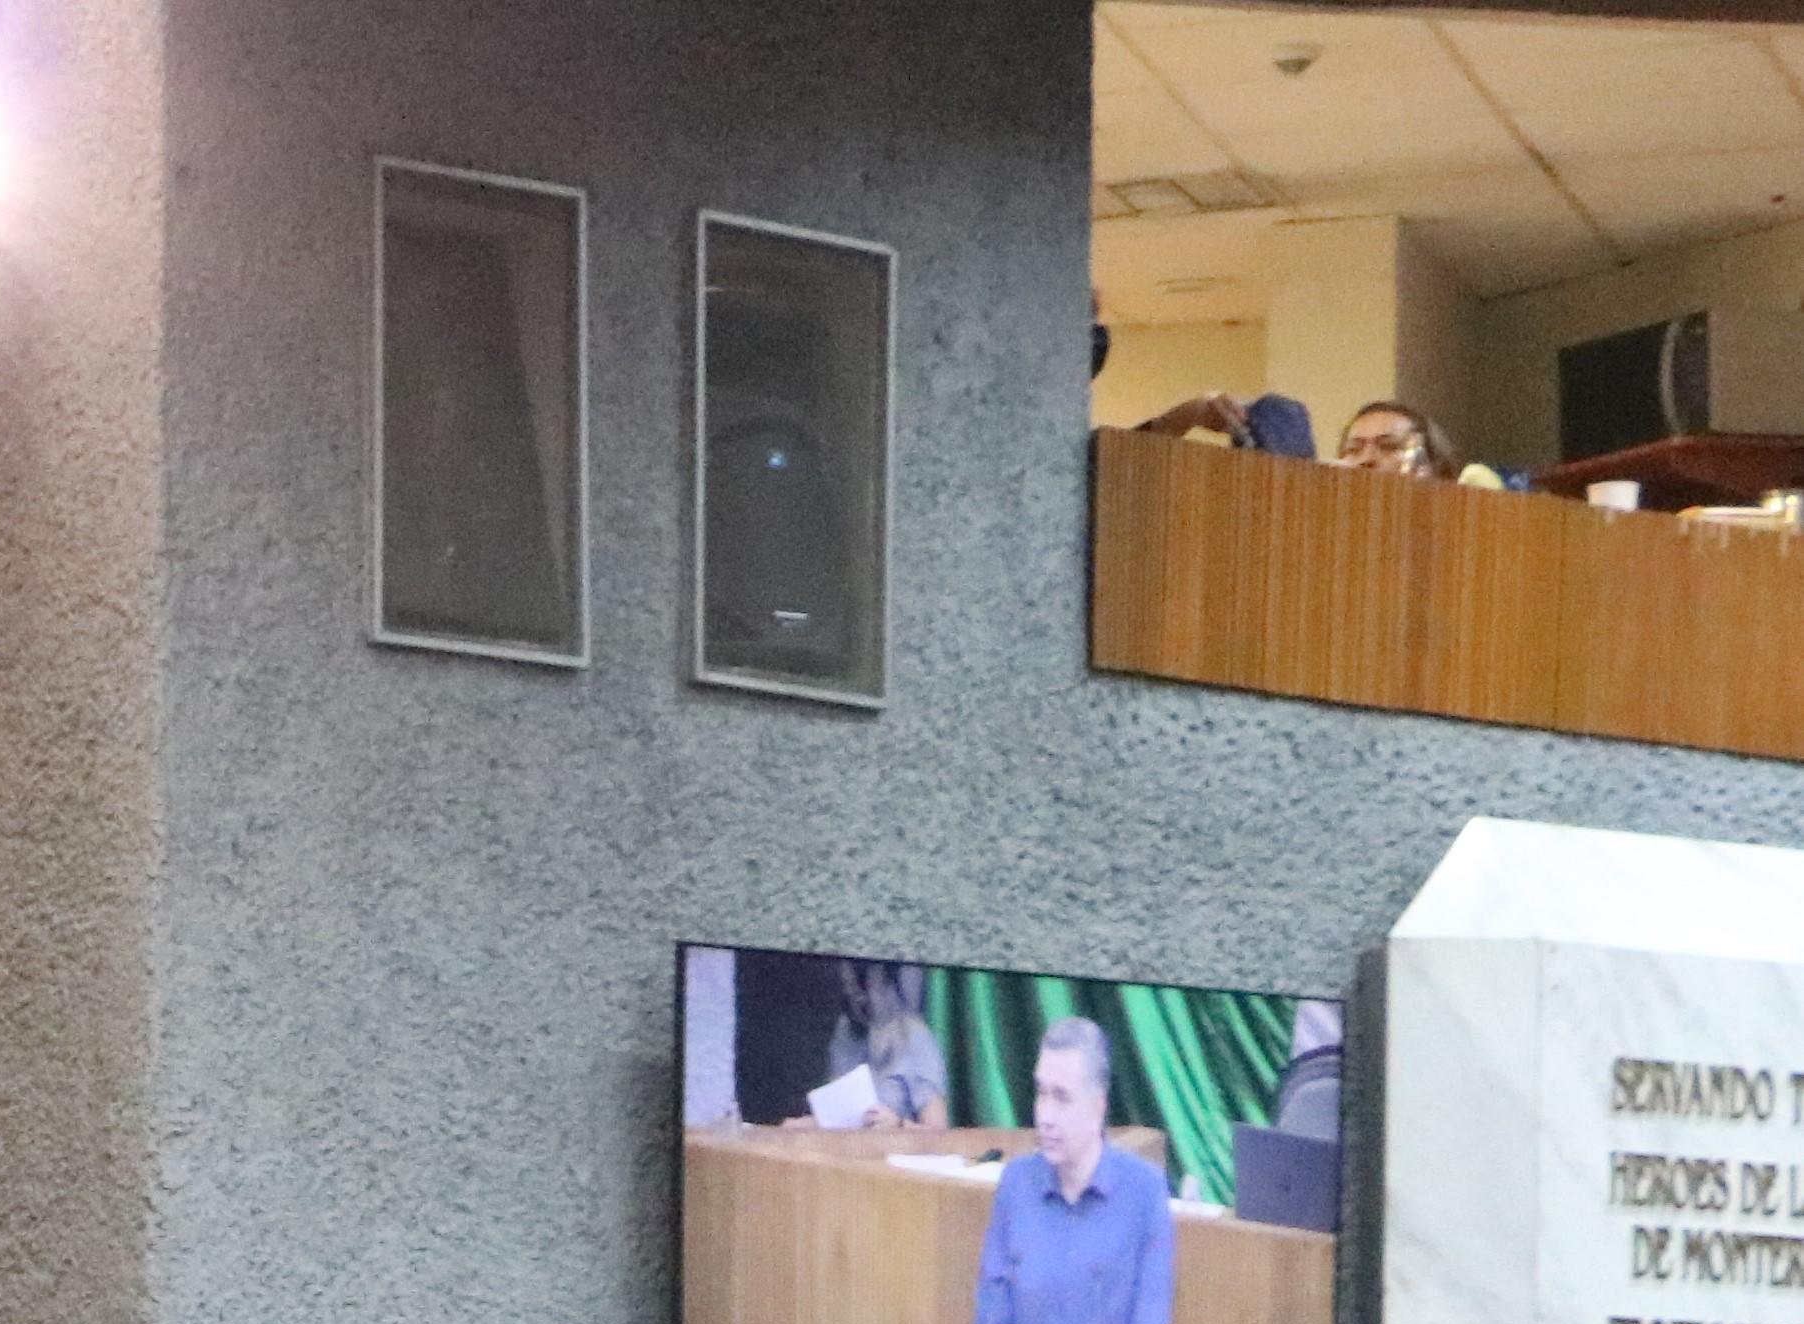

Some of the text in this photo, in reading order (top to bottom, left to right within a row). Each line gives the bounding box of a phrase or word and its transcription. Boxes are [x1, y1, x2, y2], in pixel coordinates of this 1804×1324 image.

[1612, 1057, 1775, 1121] SERVANDO
[1608, 1150, 1728, 1210] HEROES
[1740, 1161, 1778, 1216] DE
[1632, 1224, 1670, 1280] DE
